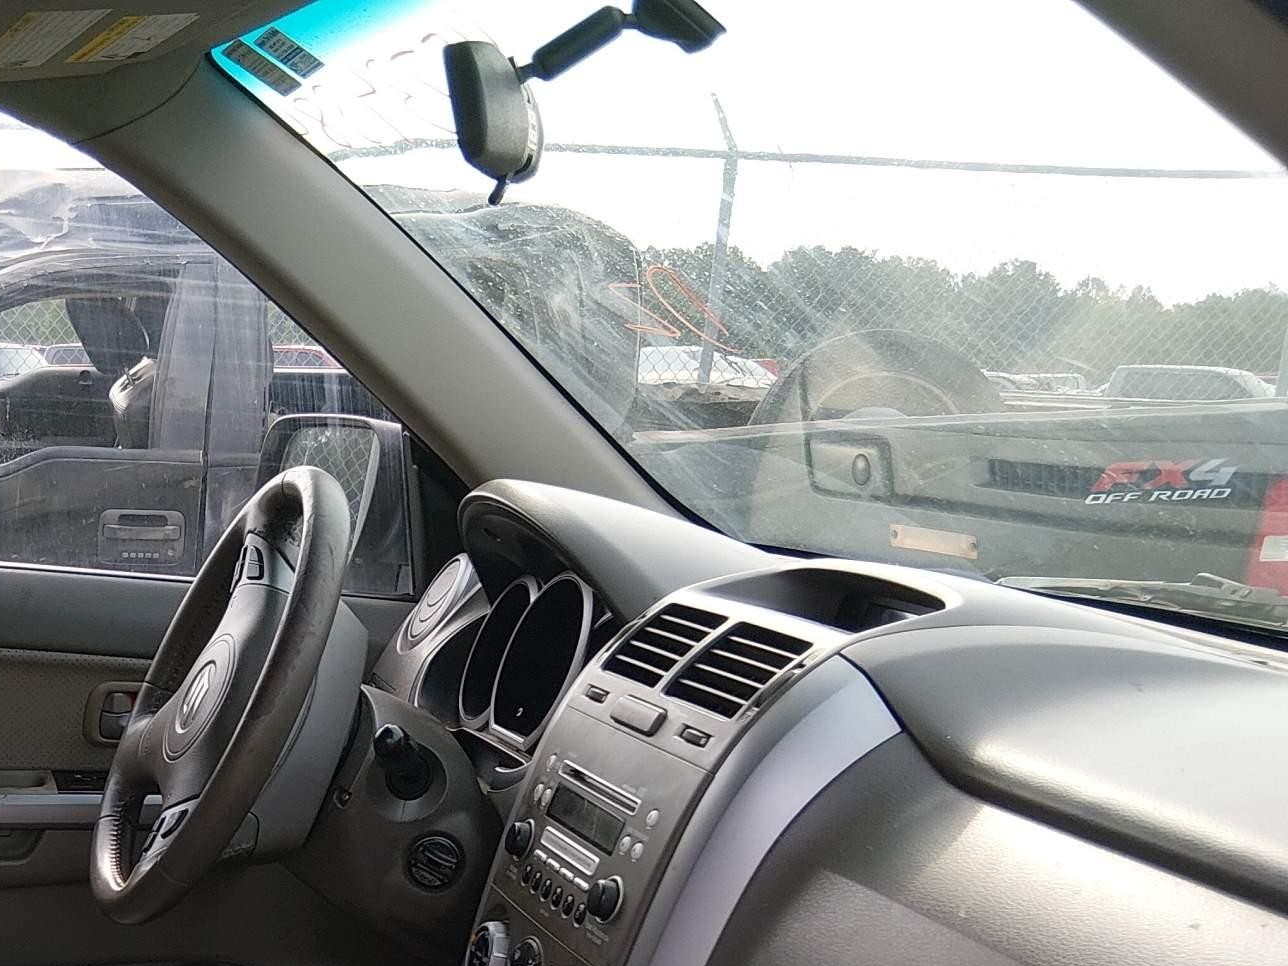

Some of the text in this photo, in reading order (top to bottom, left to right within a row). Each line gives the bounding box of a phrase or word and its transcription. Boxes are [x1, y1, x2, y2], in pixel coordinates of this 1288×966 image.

[1090, 458, 1240, 492] FX4
[1085, 488, 1232, 505] OFF ROAD
